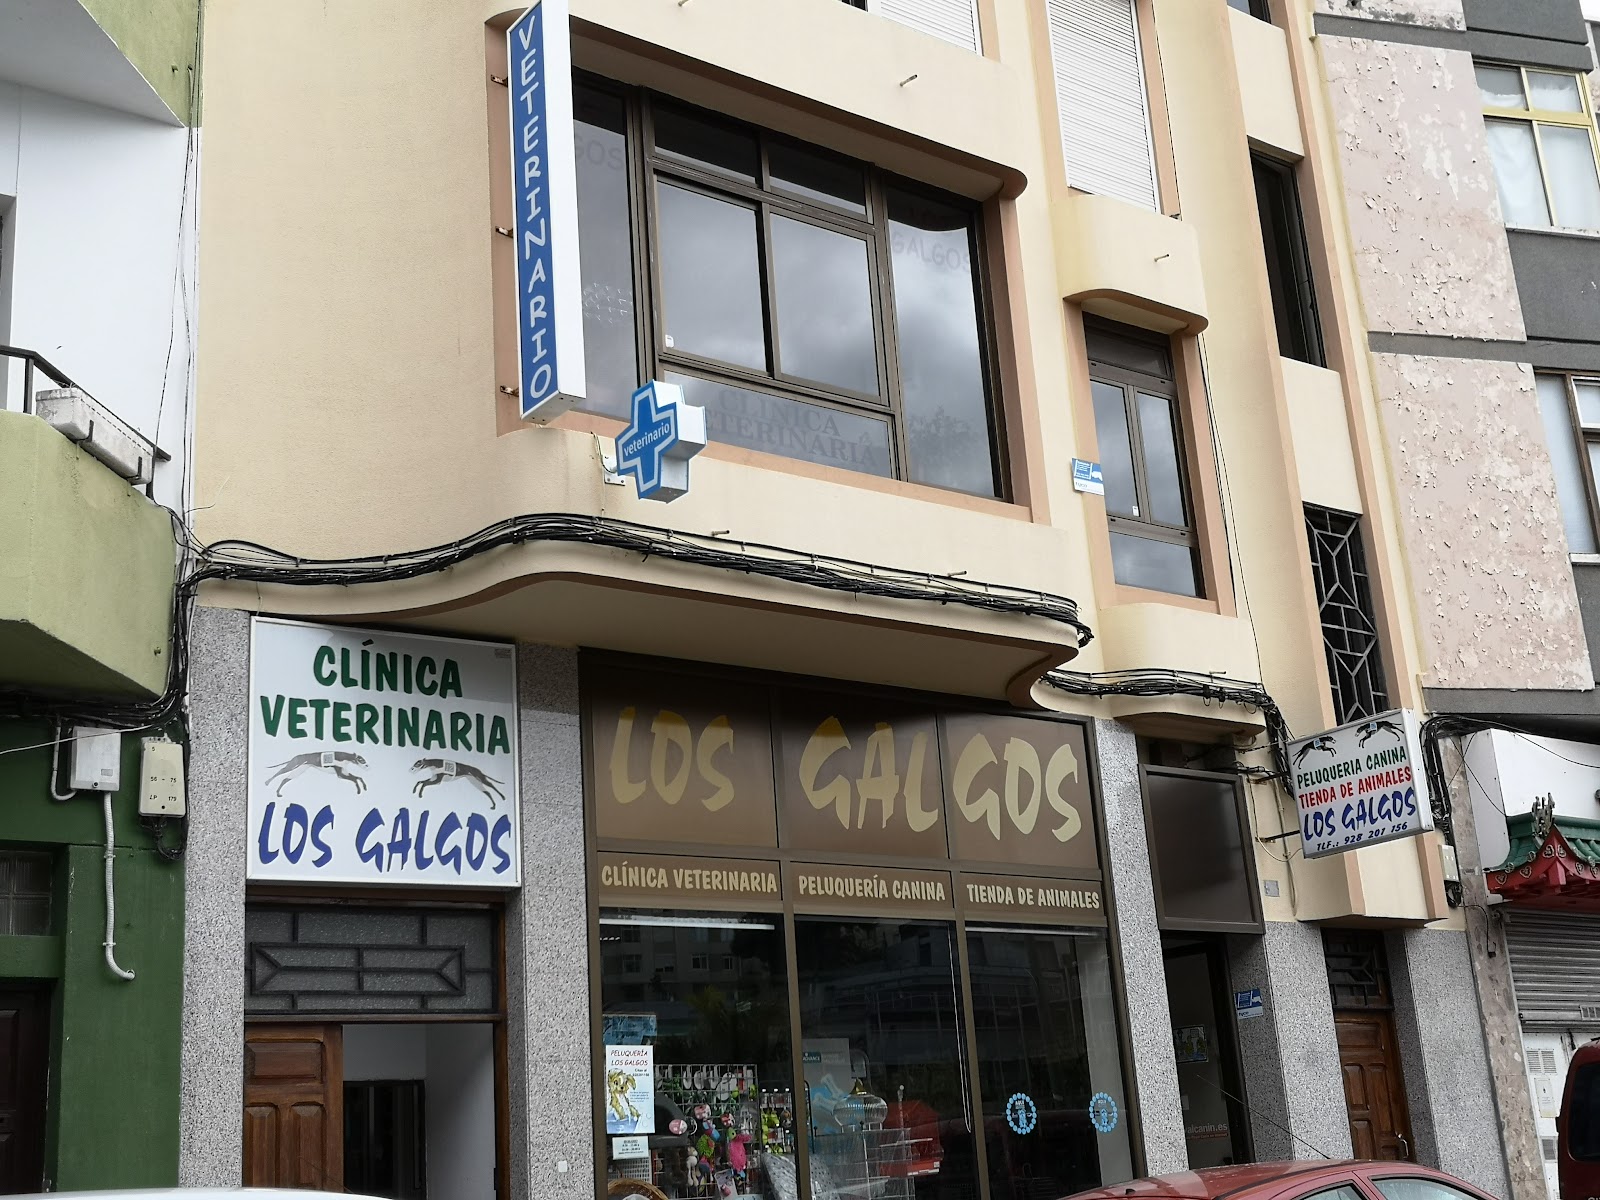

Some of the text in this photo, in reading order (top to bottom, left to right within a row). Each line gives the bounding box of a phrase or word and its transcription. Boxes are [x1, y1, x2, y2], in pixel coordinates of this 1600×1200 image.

[518, 15, 552, 398] VETERINARIO
[623, 422, 670, 457] veterinario
[706, 408, 878, 468] ETERINARIA
[313, 638, 463, 699] CLÍNICA
[260, 694, 511, 755] VETERINARIA
[609, 705, 1083, 843] LOS GALGOS
[1297, 745, 1407, 789] PELUQUERIA CANINA
[1298, 766, 1412, 809] TIENDA DE ANIMALES
[1303, 786, 1417, 841] LOS GALGOS
[1344, 833, 1364, 845] 928
[1368, 827, 1386, 839] 201
[1391, 822, 1408, 833] 156
[258, 802, 512, 875] LOS GALGOS
[601, 860, 778, 893] CLÍNICA VETERINARIA
[798, 874, 946, 902] PELUQUERÍA CANINA
[966, 884, 1100, 909] TIENDA DE ANIMALES
